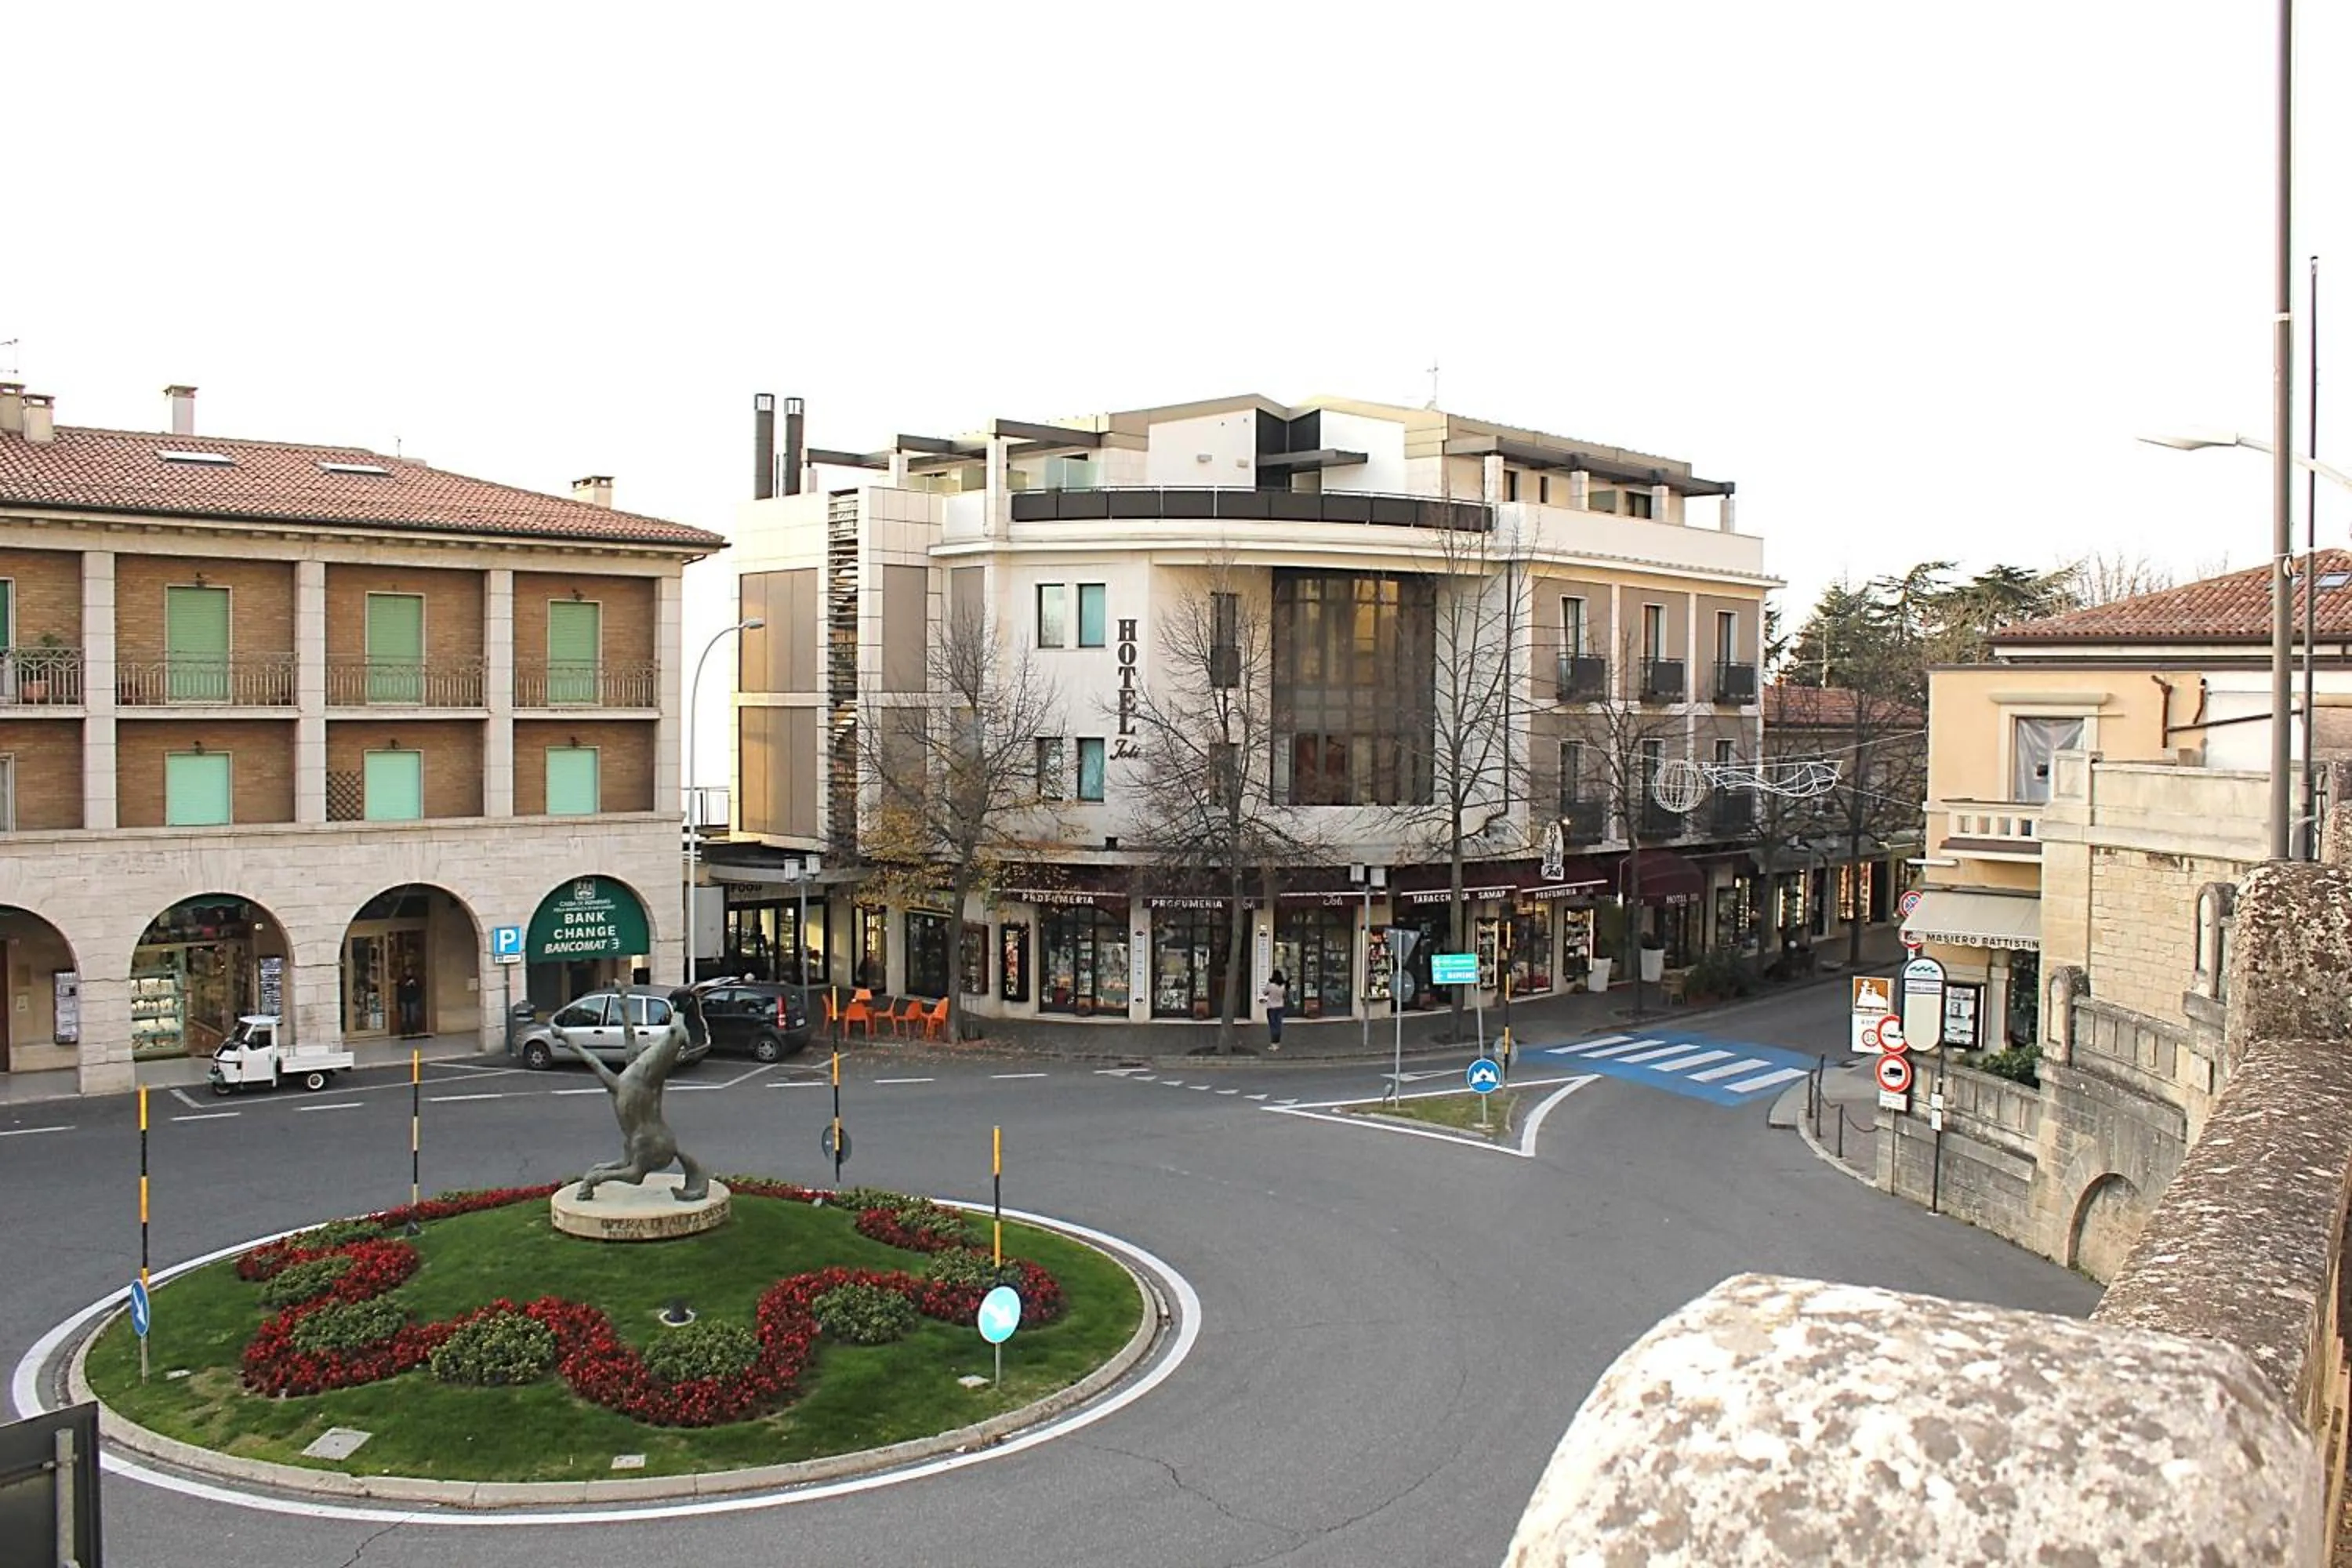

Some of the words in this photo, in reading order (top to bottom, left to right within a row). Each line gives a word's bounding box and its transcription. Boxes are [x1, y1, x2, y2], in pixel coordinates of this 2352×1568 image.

[1117, 619, 1138, 735] HOTEL
[1109, 739, 1141, 760] Joli
[1413, 891, 1471, 904] TABACCHIA
[564, 911, 606, 924] BANK
[554, 925, 616, 939] CHANGE
[499, 929, 517, 952] P
[1926, 934, 1977, 945] MASIERO
[544, 940, 608, 954] BANCOMAT
